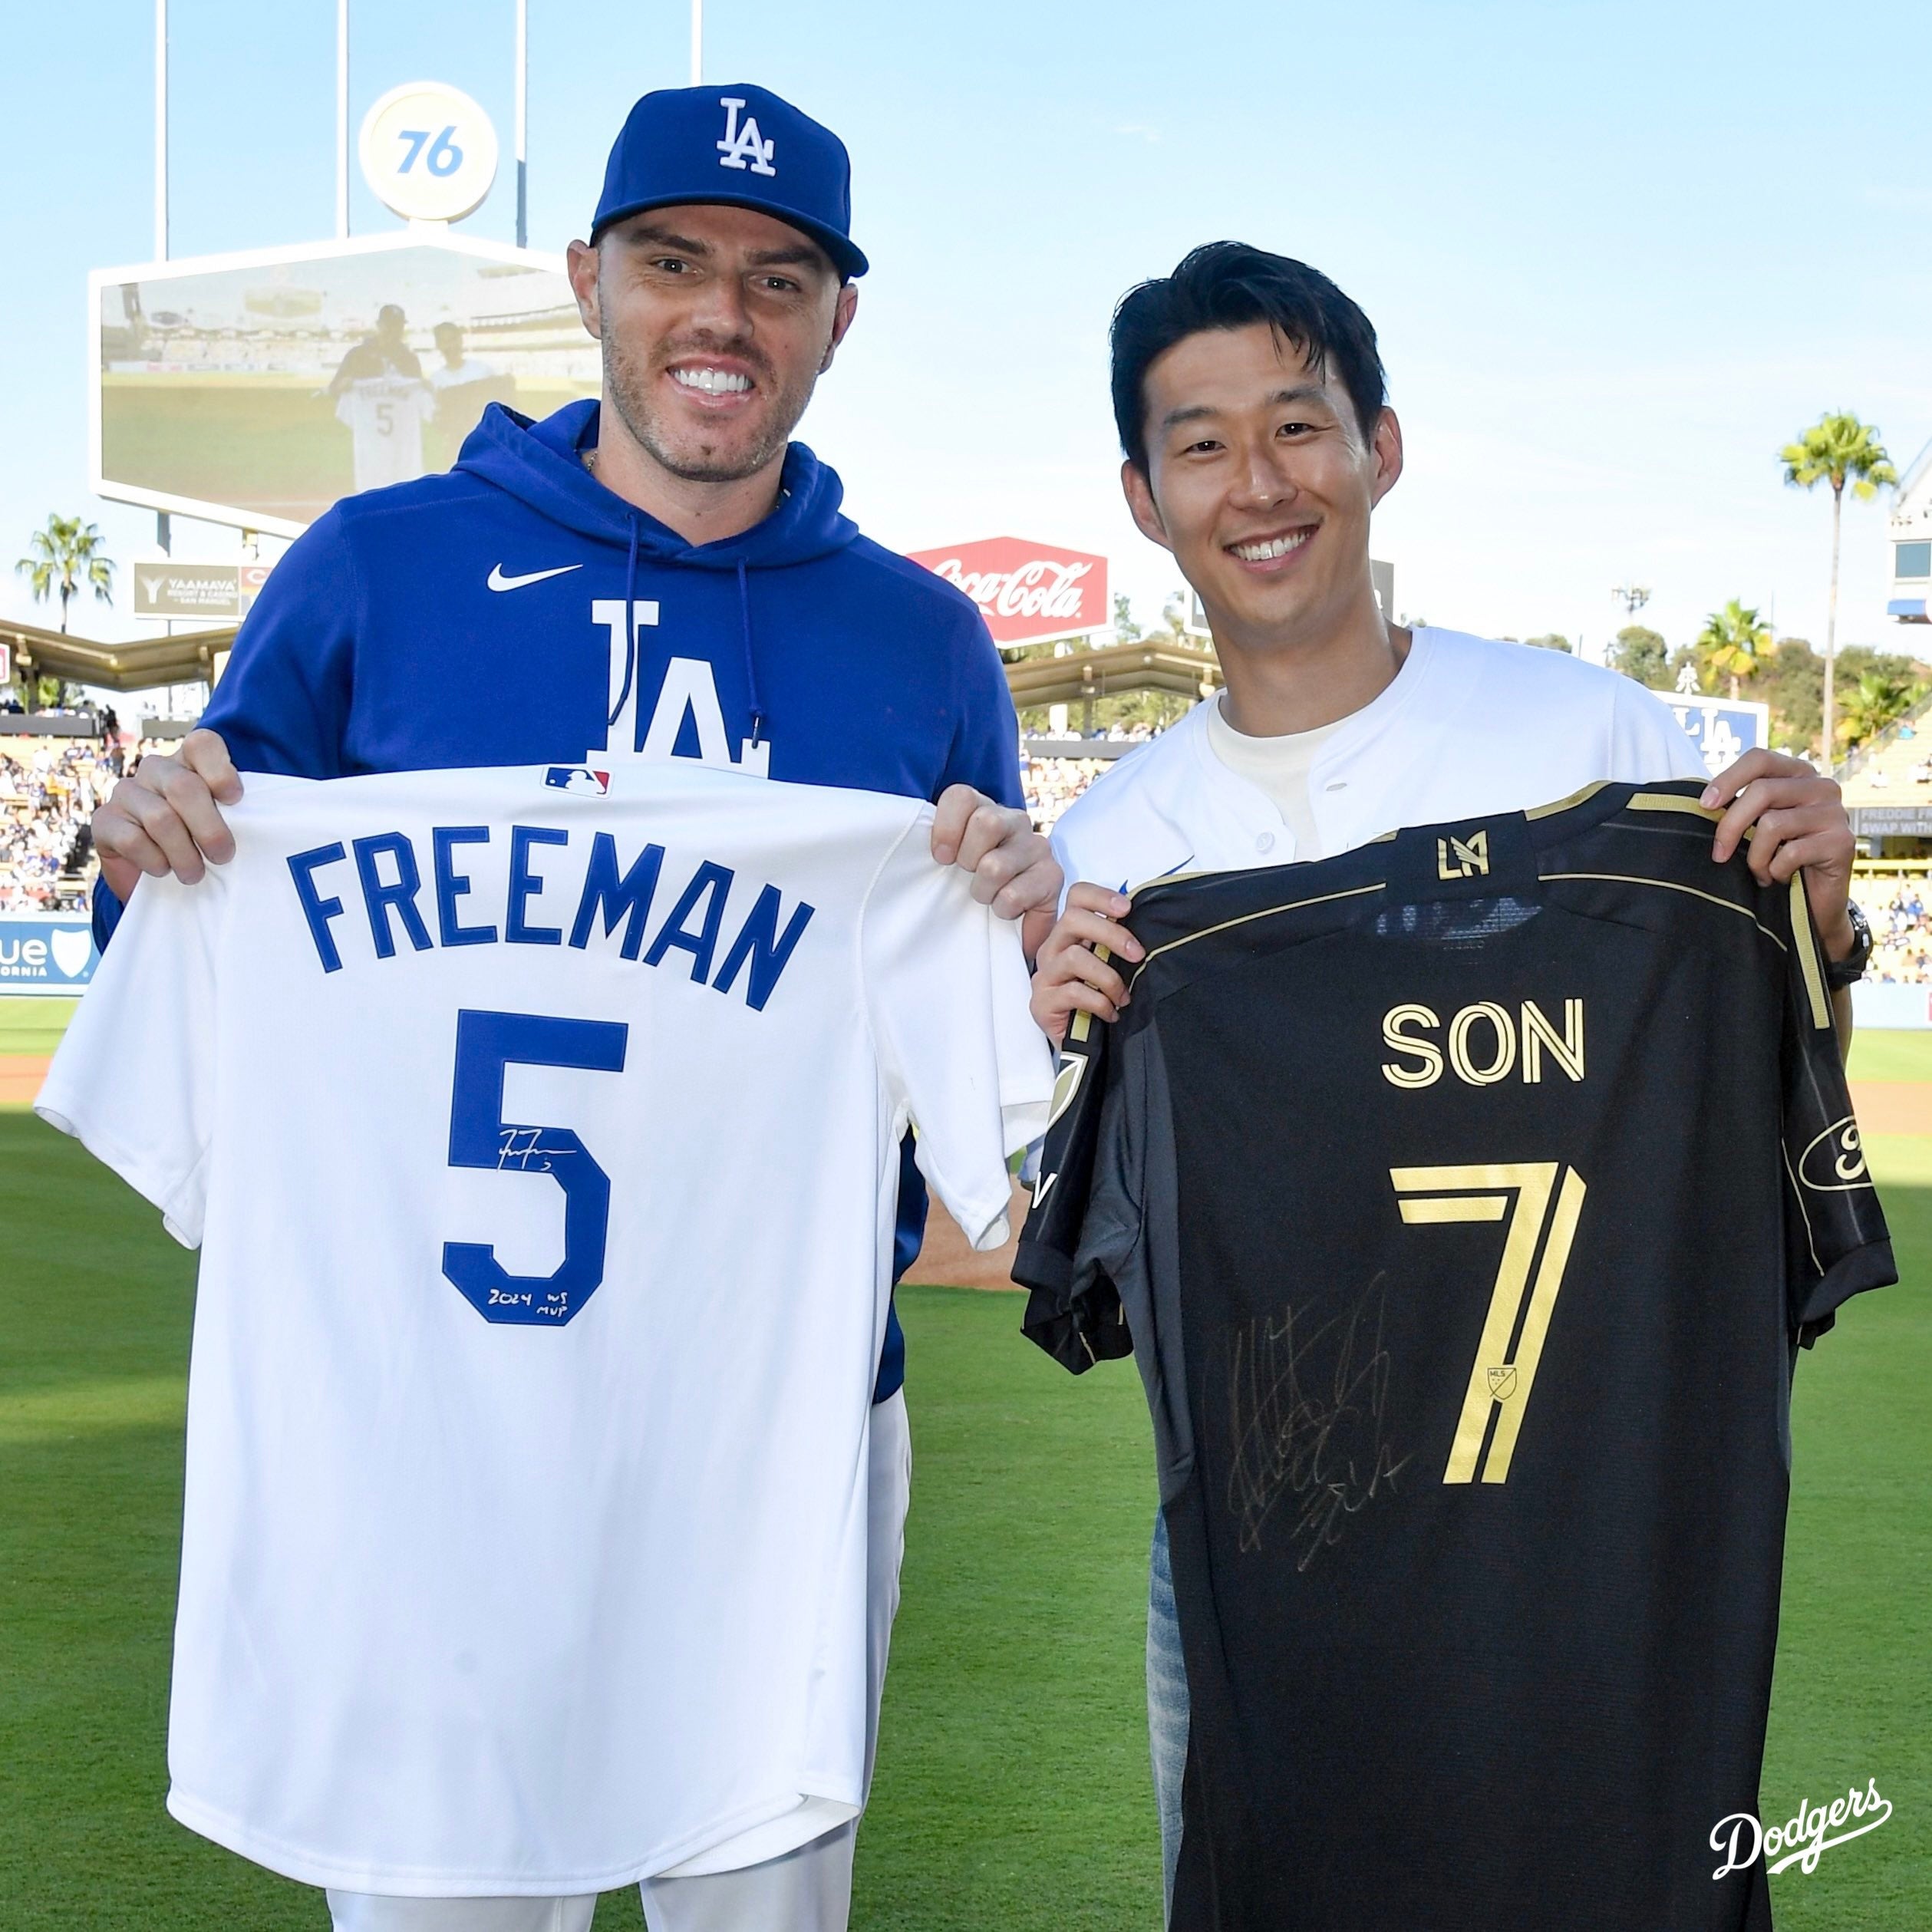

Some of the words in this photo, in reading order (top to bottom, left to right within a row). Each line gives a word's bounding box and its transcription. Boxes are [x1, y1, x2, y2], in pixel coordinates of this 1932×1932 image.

[397, 126, 463, 177] 76
[717, 97, 776, 177] LA
[377, 403, 394, 437] 5
[586, 599, 770, 779] LA
[286, 825, 815, 1012] FREEMAN
[1381, 999, 1584, 1089] SON
[442, 1008, 628, 1326] 5
[488, 1288, 532, 1306] 2024
[536, 1306, 568, 1317] MVP
[1389, 1162, 1587, 1484] 7
